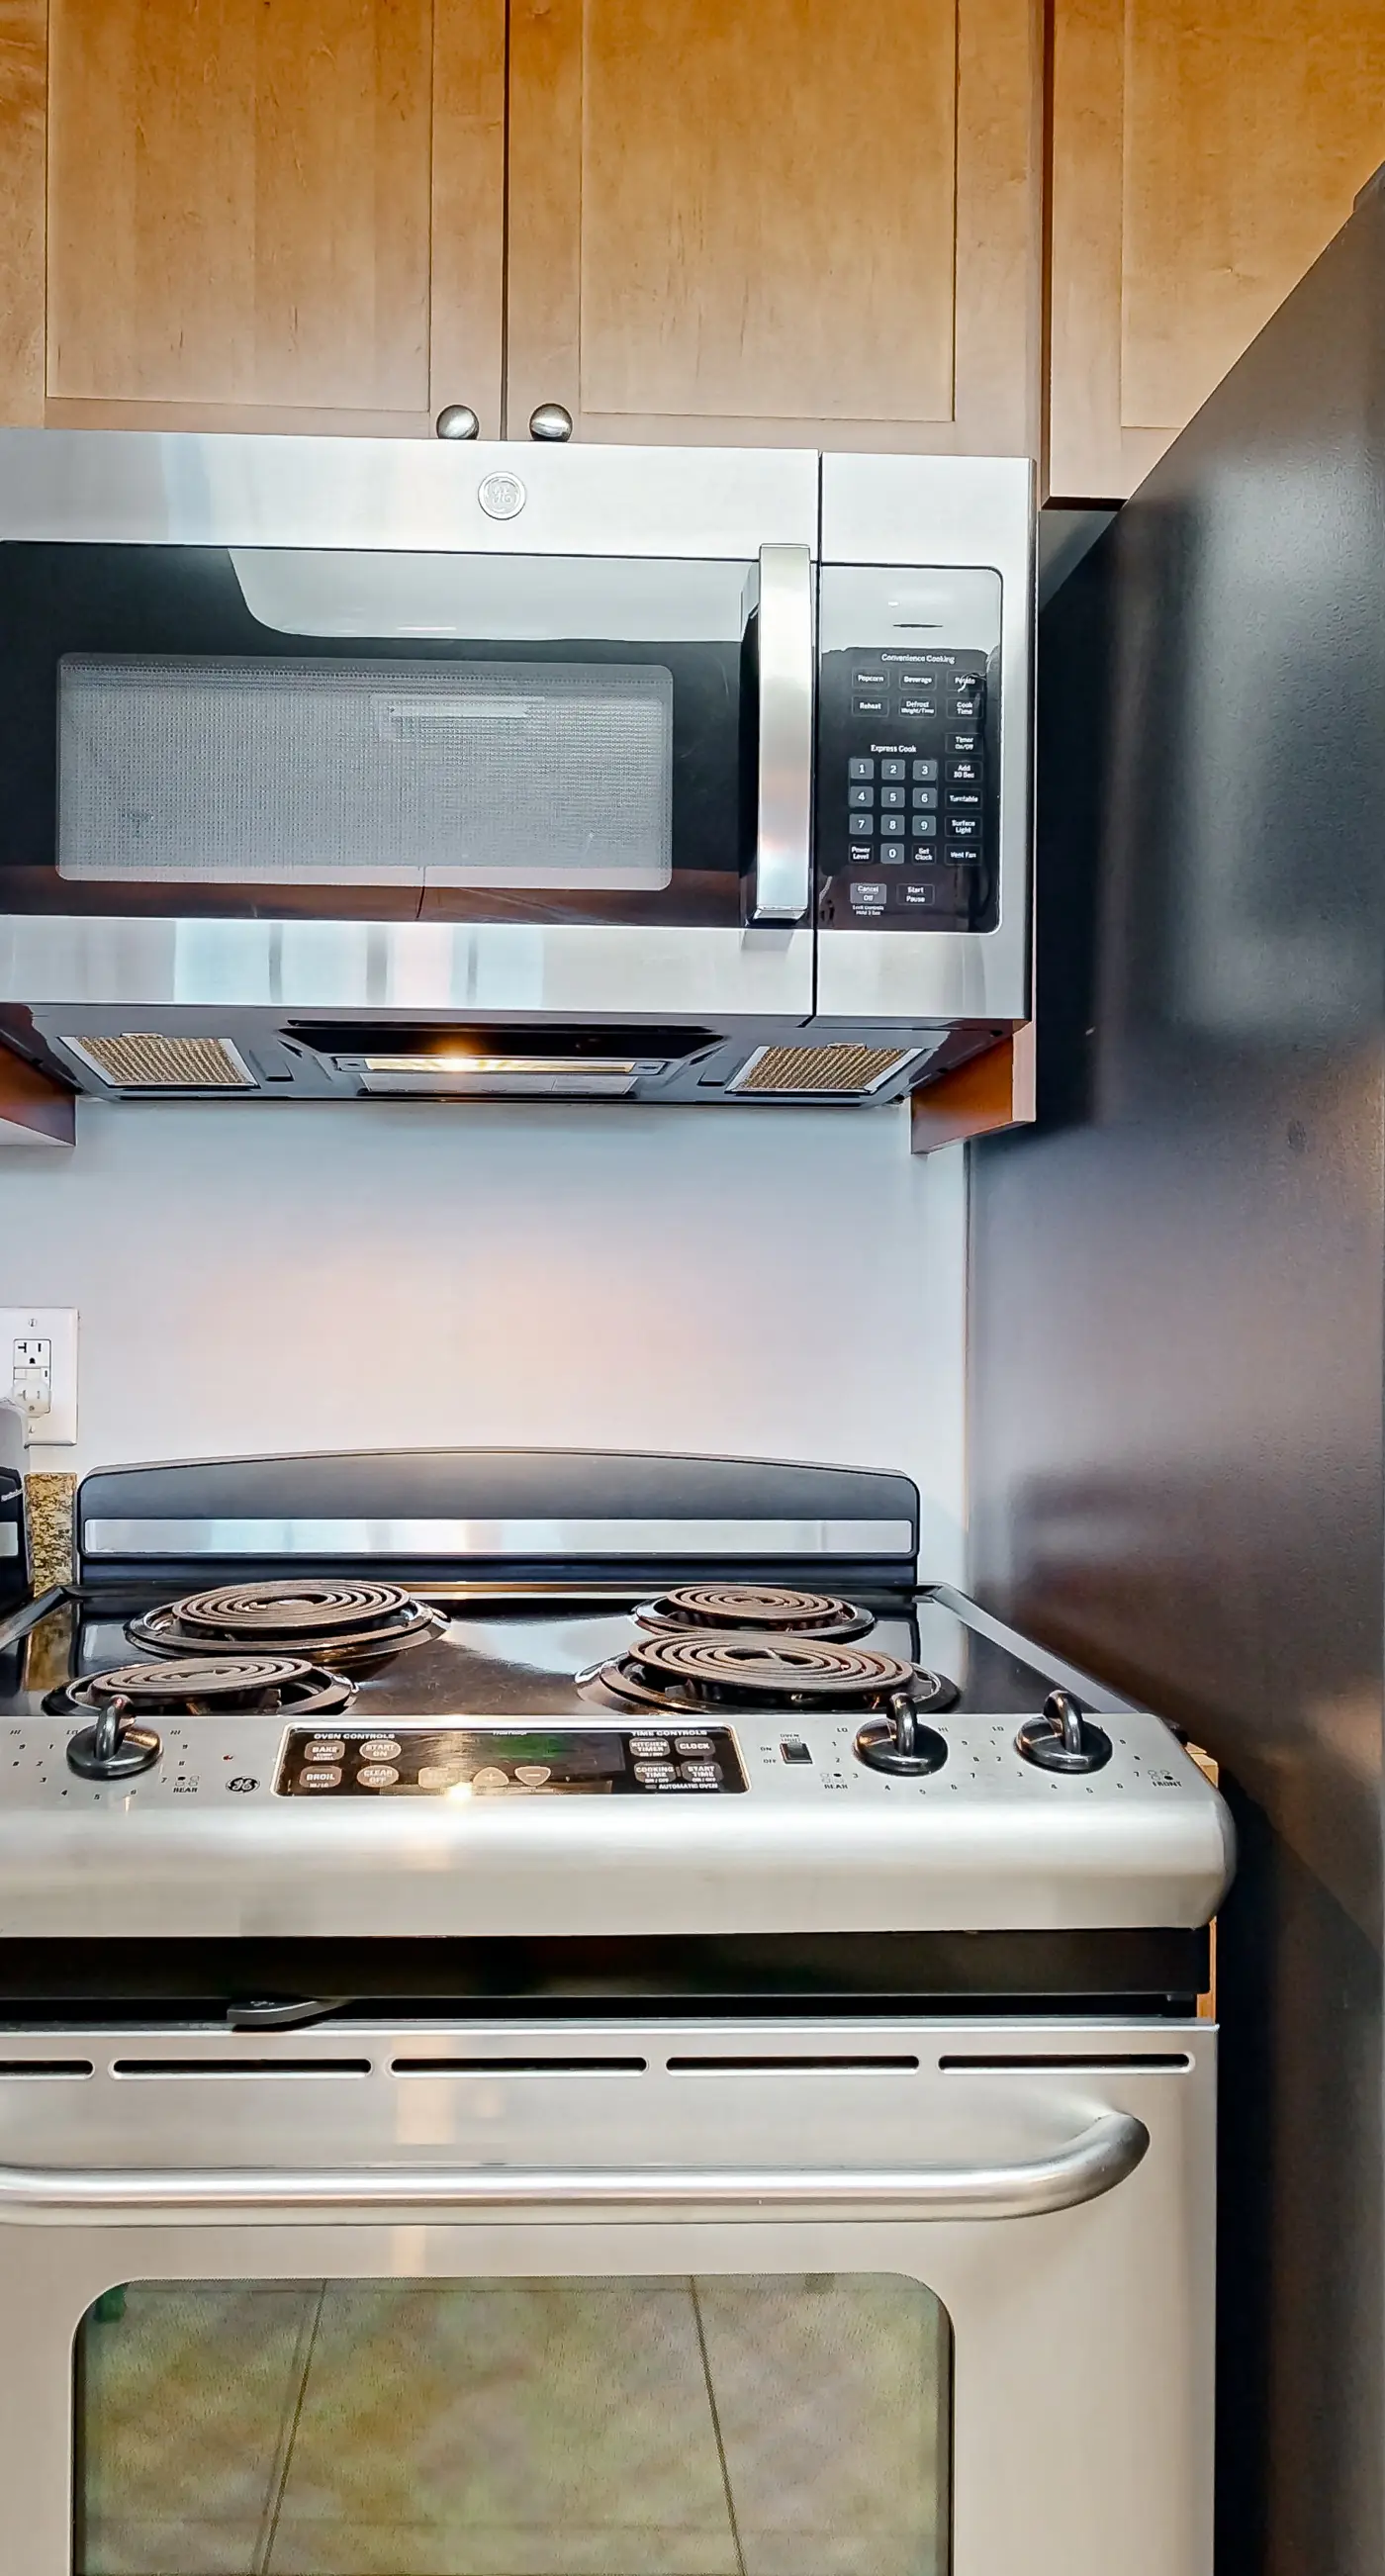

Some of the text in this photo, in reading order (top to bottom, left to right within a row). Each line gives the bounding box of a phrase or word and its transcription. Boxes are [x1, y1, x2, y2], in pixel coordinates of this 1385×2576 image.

[881, 654, 955, 664] Convenience Cooking
[858, 675, 884, 683] Popcorn
[904, 676, 932, 684] Beverage
[871, 745, 897, 753] Express
[859, 765, 865, 773] 1
[890, 765, 896, 774] 2
[922, 766, 928, 774] 3
[858, 792, 865, 801] 4
[890, 793, 896, 801] 5
[922, 793, 928, 802] 6
[858, 820, 865, 828] 7
[890, 821, 896, 829] 8
[921, 821, 927, 829] 9
[889, 849, 896, 858] 0
